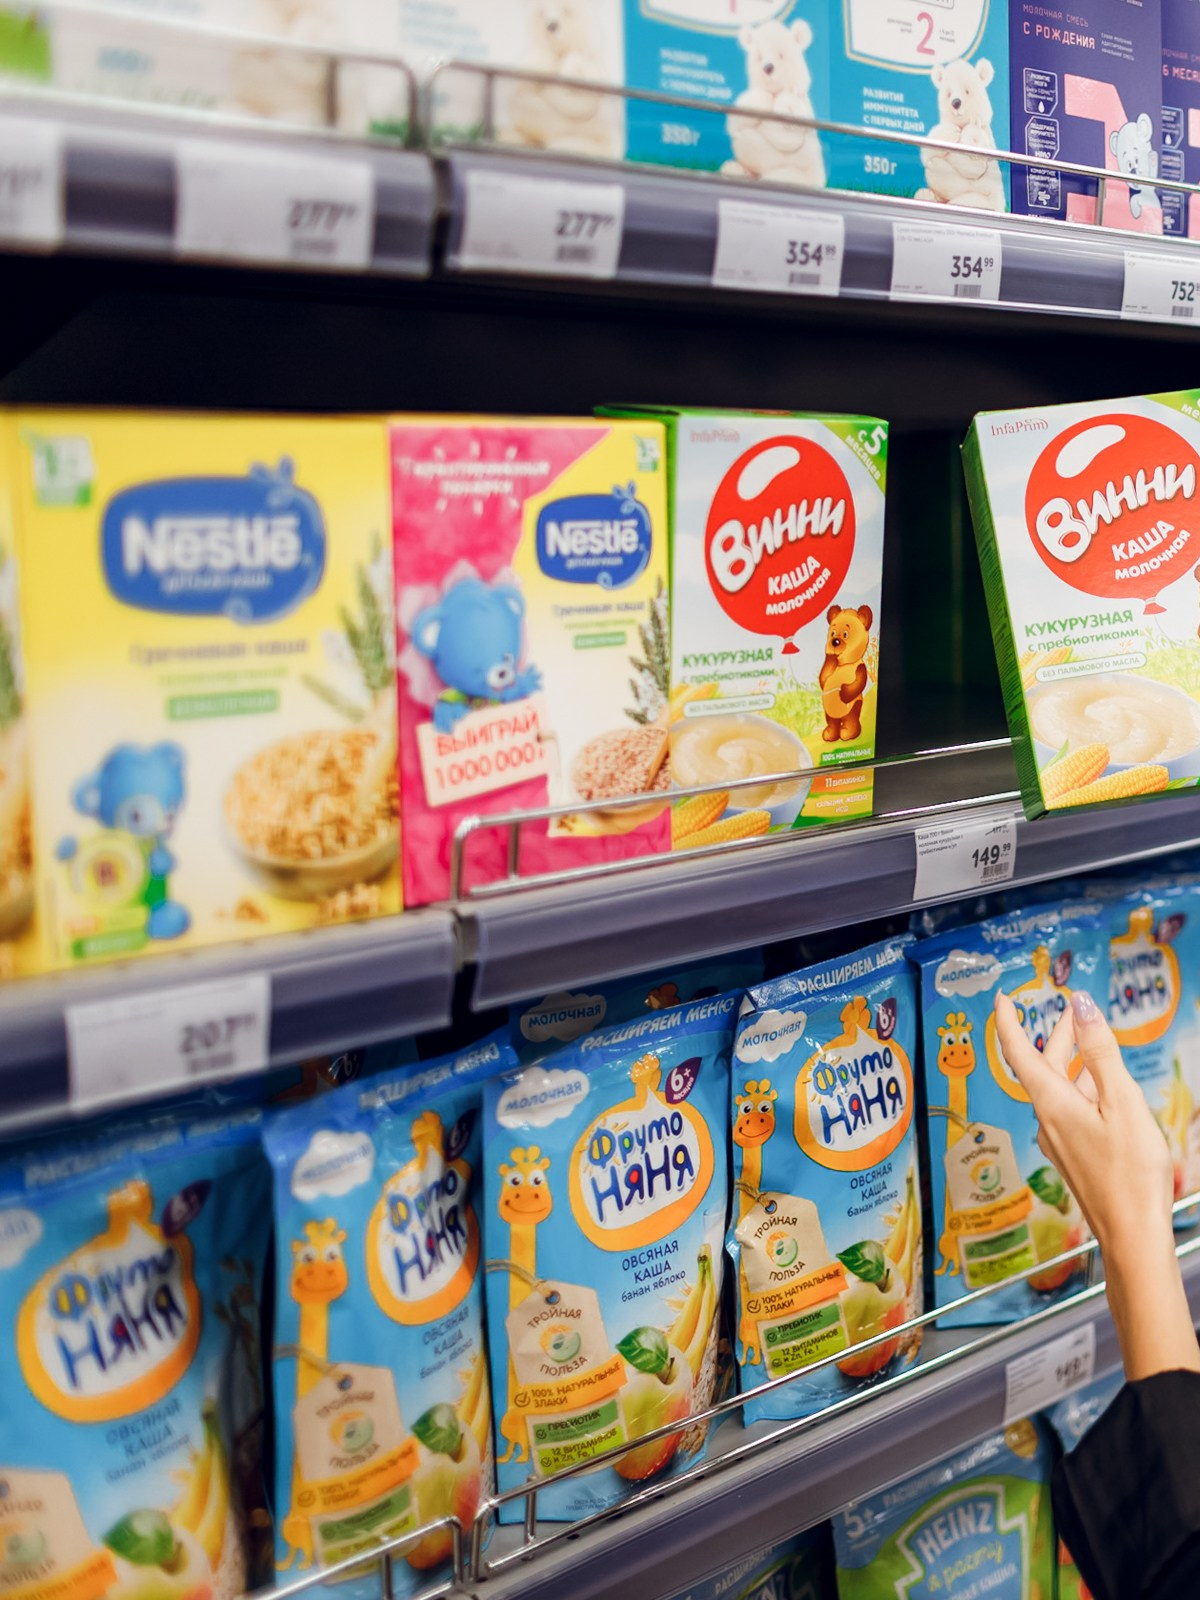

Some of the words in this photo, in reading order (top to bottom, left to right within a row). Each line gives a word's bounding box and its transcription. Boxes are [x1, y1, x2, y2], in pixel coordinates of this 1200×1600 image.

[1023, 4, 1063, 20] МОЛОЧНАЯ
[1066, 14, 1089, 28] СМЕСЬ
[917, 11, 935, 56] 2
[1035, 24, 1096, 50] РОЖДЕНИЯ
[951, 255, 983, 279] 354
[1171, 280, 1195, 301] 752
[864, 425, 888, 455] 5
[991, 417, 1049, 437] InfaPrim
[845, 434, 881, 480] месяцев
[545, 518, 640, 558] Nestlé
[1111, 519, 1176, 563] КАША
[1114, 529, 1191, 581] молочная
[767, 555, 821, 596] КАША
[765, 567, 832, 616] молочная
[1024, 609, 1134, 638] КУКУРУЗНАЯ
[1037, 627, 1139, 653] пребиотиками
[682, 647, 774, 668] КУКУРУЗНАЯ
[1042, 669, 1056, 679] БЕЗ
[1057, 660, 1111, 677] ПАЛЬМОВОГО
[1112, 656, 1140, 668] МАСЛА
[689, 668, 775, 686] пребиотиками
[972, 844, 1000, 868] 149
[1003, 842, 1011, 852] 99
[799, 956, 874, 995] РАСШИРЯЕМ
[940, 962, 993, 984] молочн
[528, 1003, 602, 1029] молочная
[581, 1011, 682, 1053] РАСШИРЯЕМ
[685, 997, 736, 1024] МЕНЮ
[742, 1020, 802, 1049] молочная
[813, 1046, 894, 1098] Фруто
[505, 1081, 583, 1112] молочная
[820, 1076, 904, 1145] НЯНЯ
[587, 1110, 684, 1169] Фруто
[590, 1143, 695, 1223] НЯНЯ
[849, 1162, 894, 1191] ОВСЯНАЯ
[860, 1181, 889, 1202] КАША
[847, 1201, 874, 1218] банан
[753, 1215, 798, 1240] ТРОЙНАЯ
[621, 1239, 680, 1272] ОВСЯНАЯ
[633, 1259, 672, 1284] КАША
[768, 1260, 807, 1283] ПОЛЬЗА
[621, 1285, 651, 1302] банан
[651, 1269, 687, 1291] яблоко
[761, 1292, 784, 1305] 100%
[784, 1268, 841, 1299] НАТУРАЛЬНЫЕ
[526, 1305, 582, 1329] ТРОЙНАЯ
[764, 1298, 795, 1315] ЗЛАКИ
[778, 1310, 823, 1333] ПРЕБИОТИК
[791, 1327, 839, 1354] ВИТАМИНОВ
[539, 1355, 588, 1378] ПОЛЬЗА
[530, 1388, 554, 1400] 100%
[556, 1361, 622, 1396] НАТУРАЛЬНЫЕ
[534, 1395, 568, 1409] ЗЛАКИ
[562, 1428, 618, 1455] ВИТАМИНОВ
[916, 1502, 994, 1564] HEINZ
